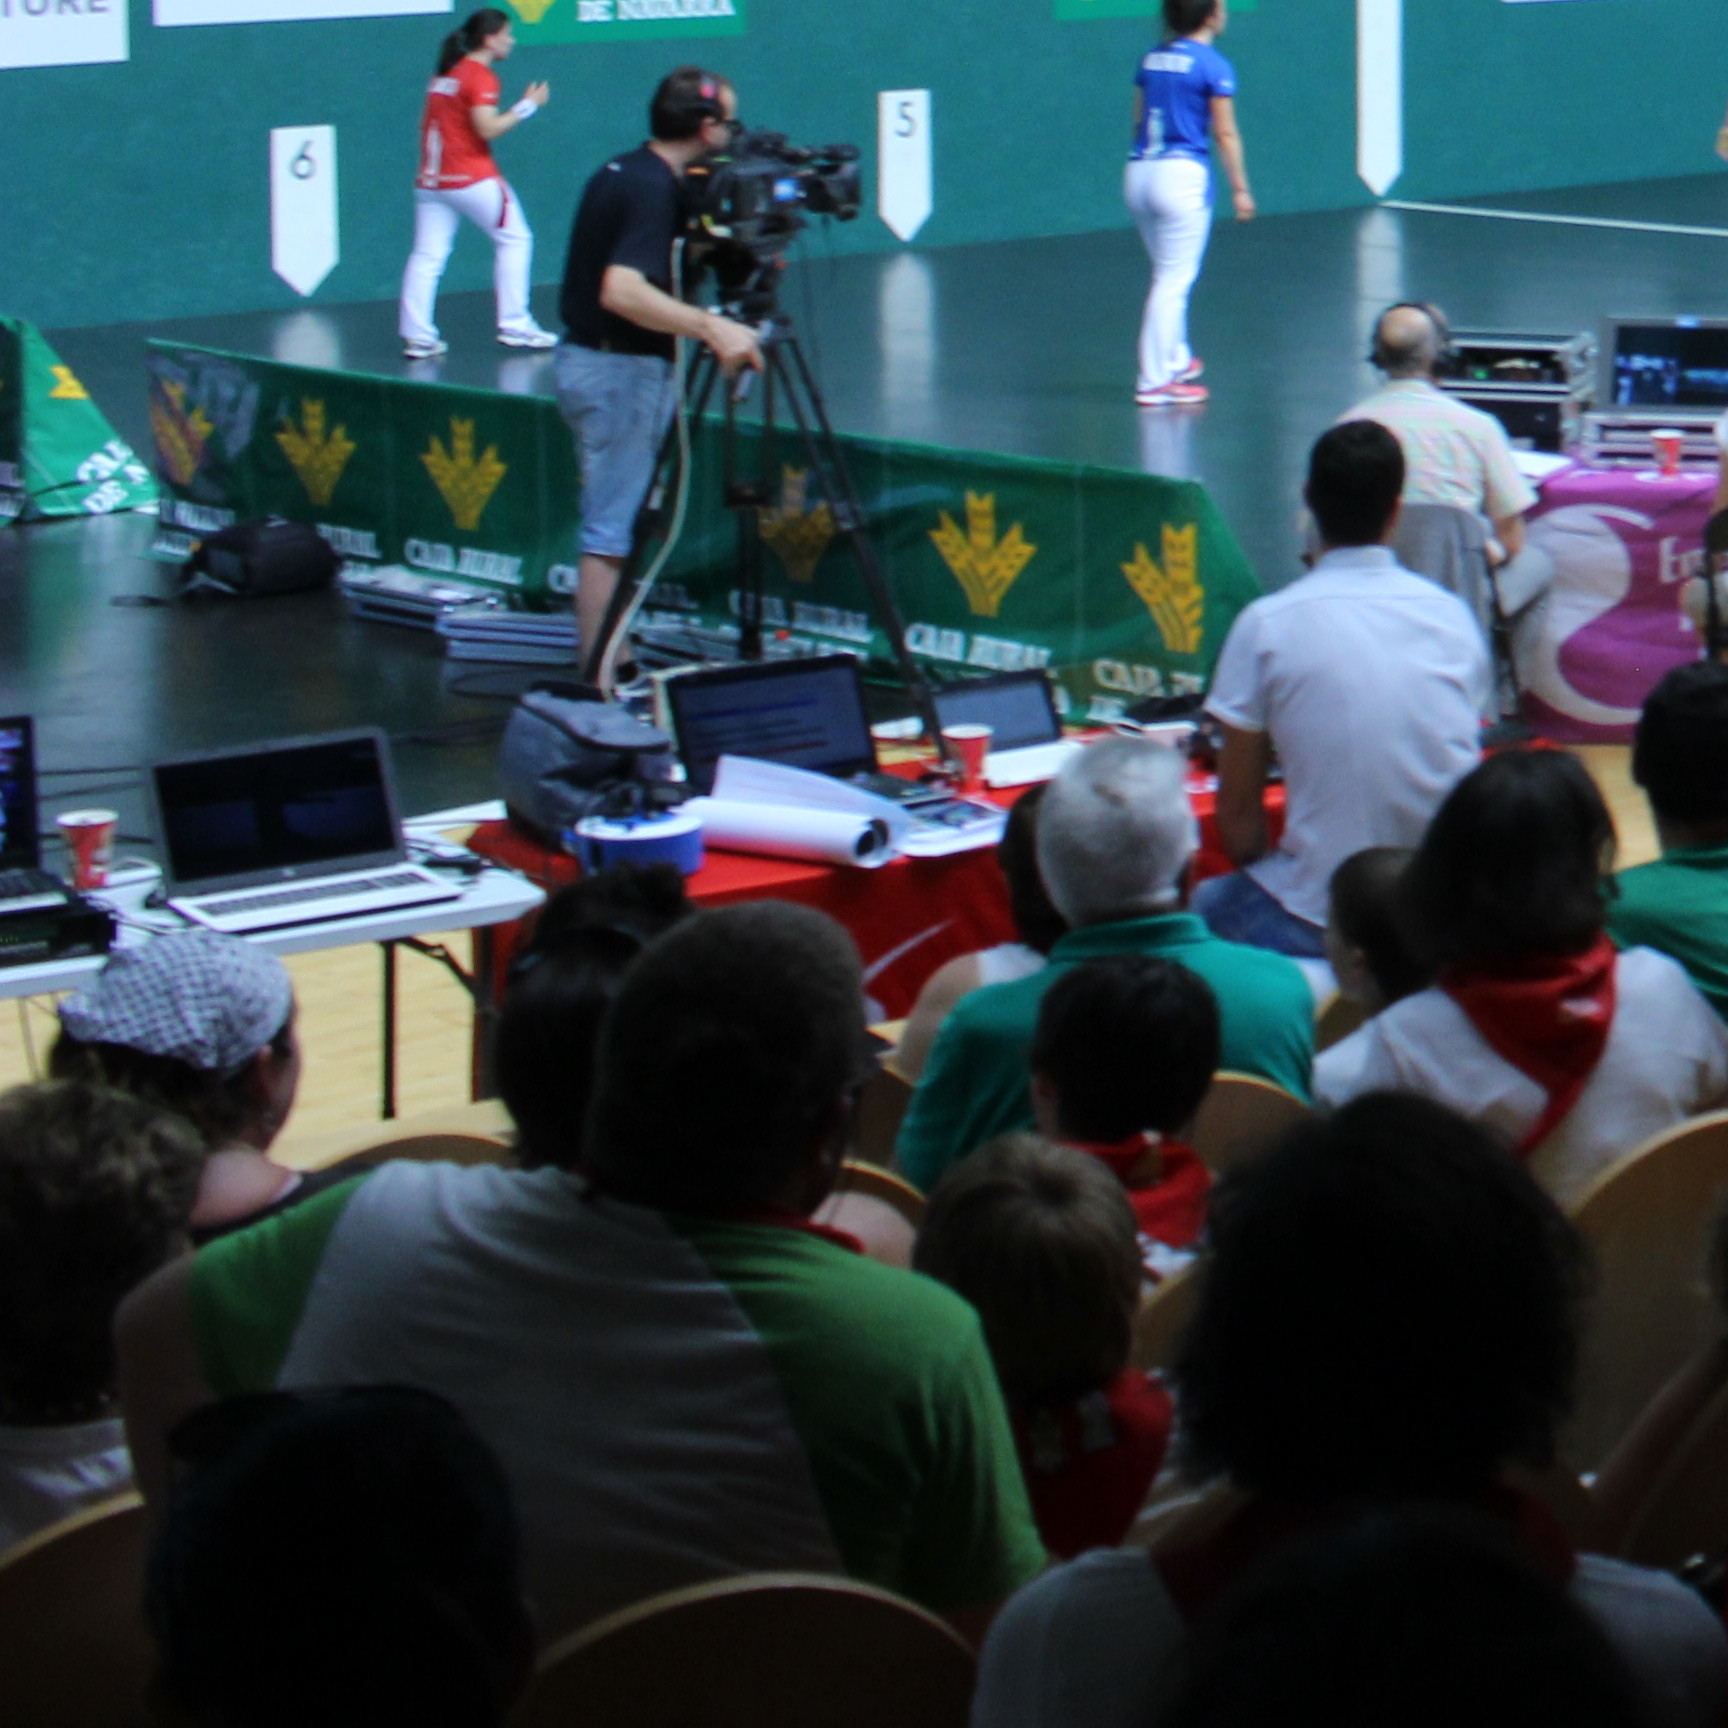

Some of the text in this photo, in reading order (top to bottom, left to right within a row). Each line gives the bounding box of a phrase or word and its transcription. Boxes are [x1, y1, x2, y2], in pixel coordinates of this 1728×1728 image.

[894, 100, 916, 138] 5
[291, 140, 318, 180] 6
[903, 622, 967, 662] CAJA
